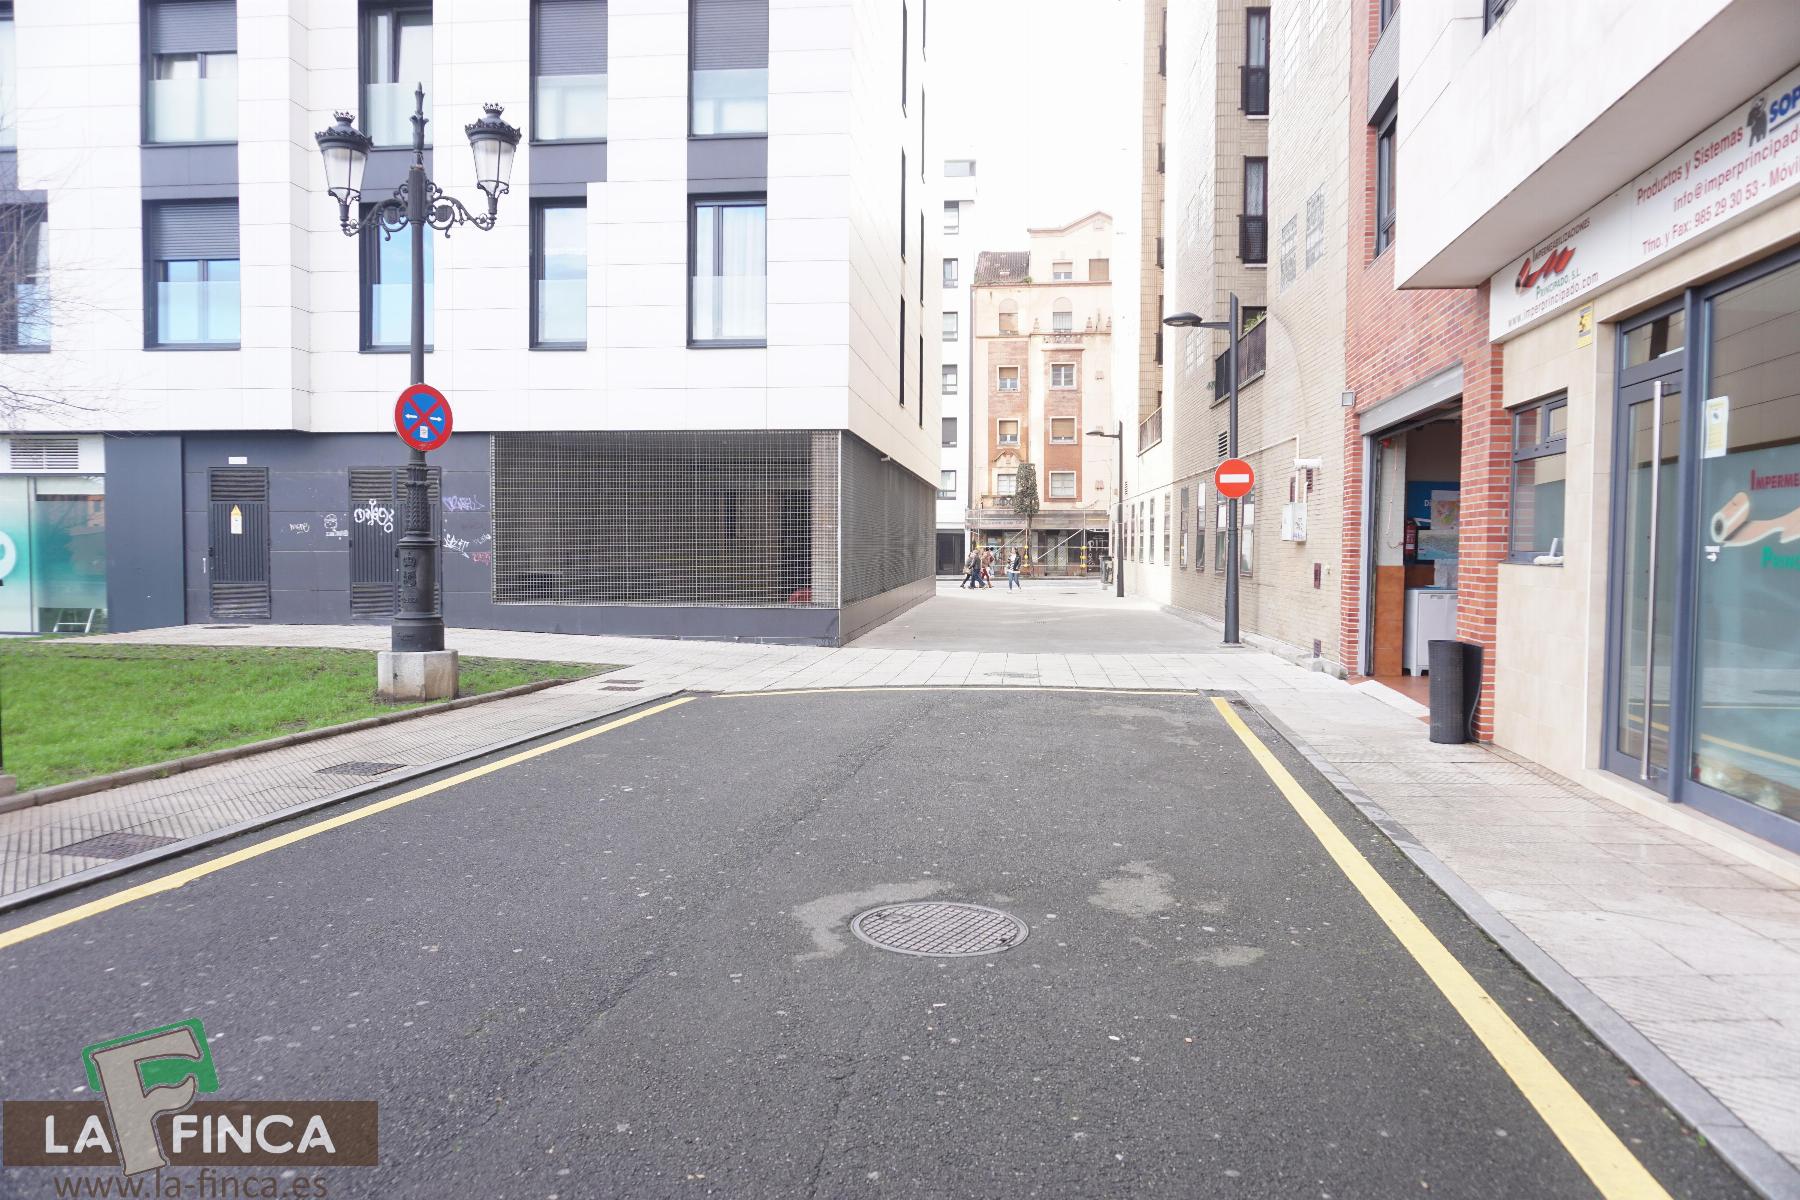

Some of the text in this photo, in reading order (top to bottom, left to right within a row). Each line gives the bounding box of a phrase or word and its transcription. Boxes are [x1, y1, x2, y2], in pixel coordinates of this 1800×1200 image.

[1636, 126, 1744, 206] Productos y Sistemas
[1673, 124, 1800, 212] info@imperprincipad
[1665, 231, 1670, 247] y
[1672, 220, 1692, 240] Fax:
[1694, 205, 1712, 228] 985
[1715, 197, 1727, 217] 29
[1730, 188, 1742, 209] 30
[1745, 179, 1758, 201] 53
